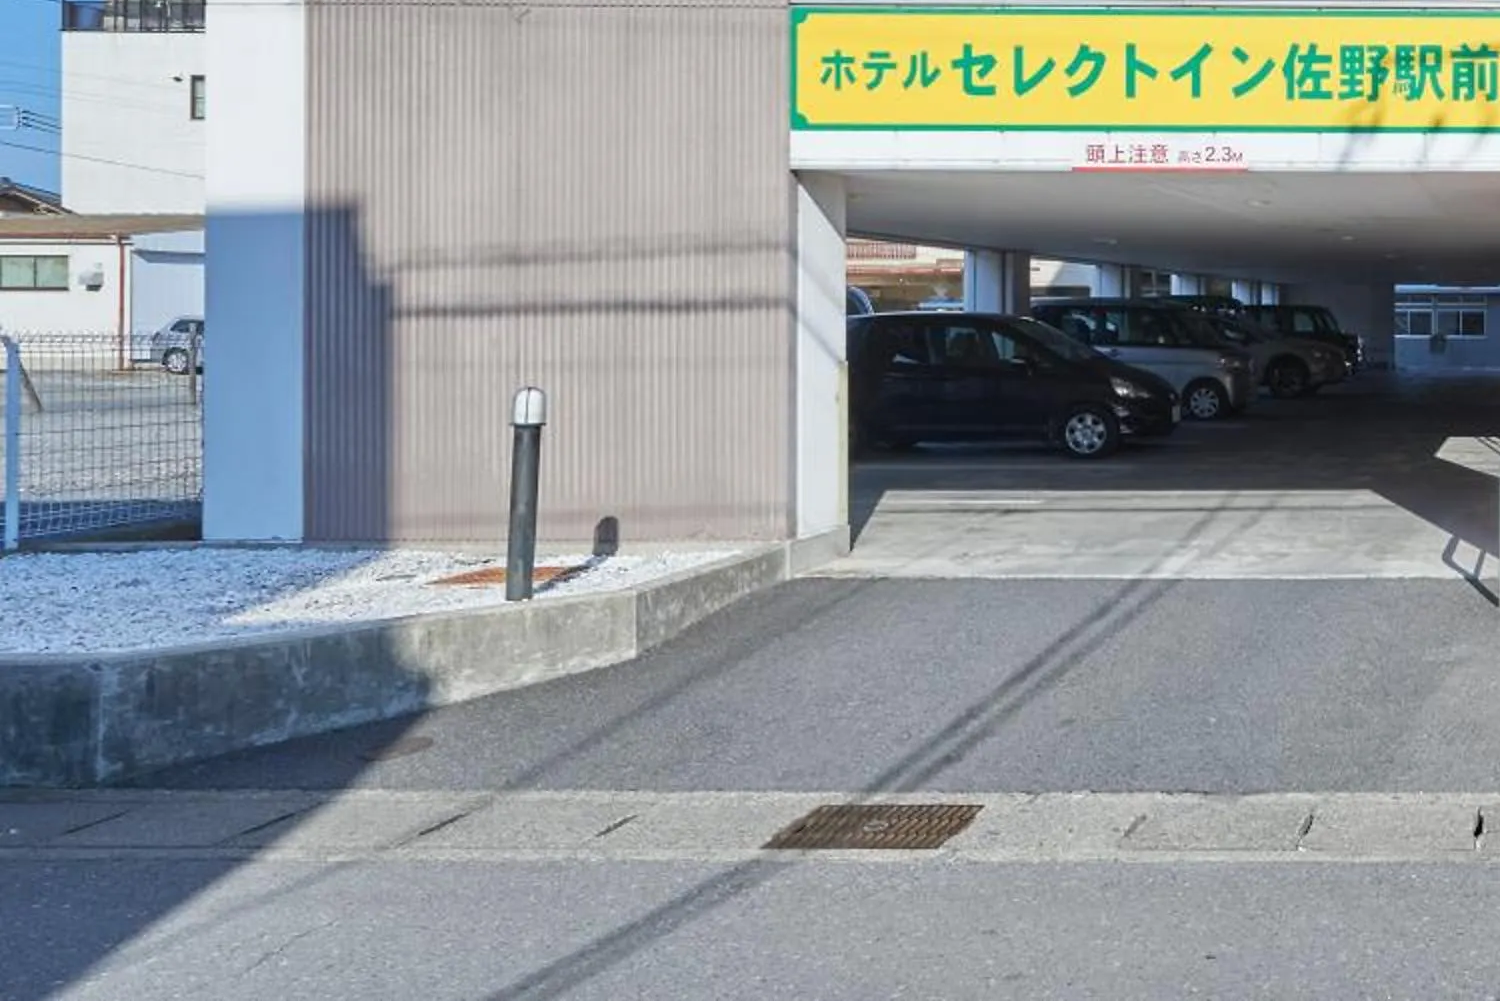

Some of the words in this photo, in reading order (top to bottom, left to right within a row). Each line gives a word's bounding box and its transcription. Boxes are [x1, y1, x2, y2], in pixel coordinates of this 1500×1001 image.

[820, 42, 1500, 102] ホテルセレクトイン佐野駅前
[1086, 143, 1169, 164] 頭上注意
